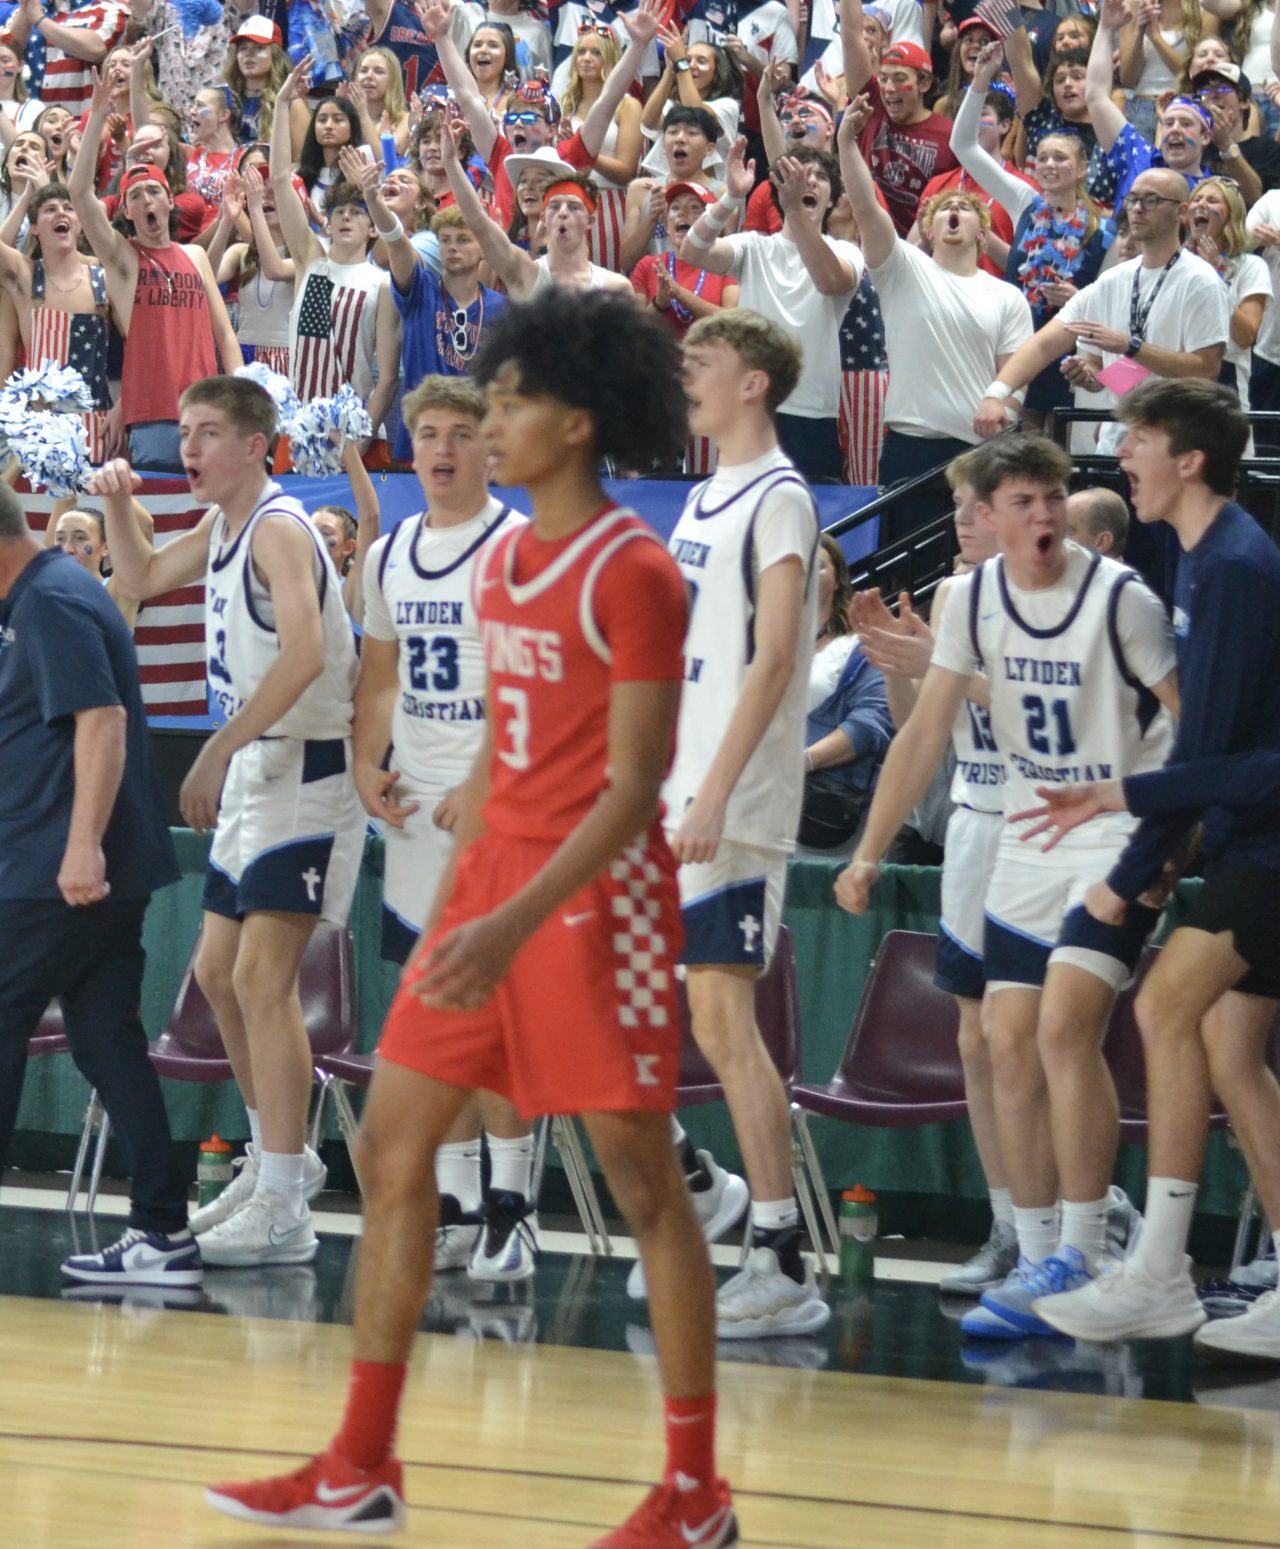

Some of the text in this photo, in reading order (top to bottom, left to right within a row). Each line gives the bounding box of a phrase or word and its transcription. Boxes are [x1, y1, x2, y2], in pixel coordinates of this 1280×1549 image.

[149, 287, 205, 309] LIBERTY
[397, 602, 463, 625] LYNDEN
[407, 635, 459, 691] 23
[1005, 656, 1081, 686] LYNDEN
[498, 686, 530, 770] 3
[1023, 694, 1077, 756] 21
